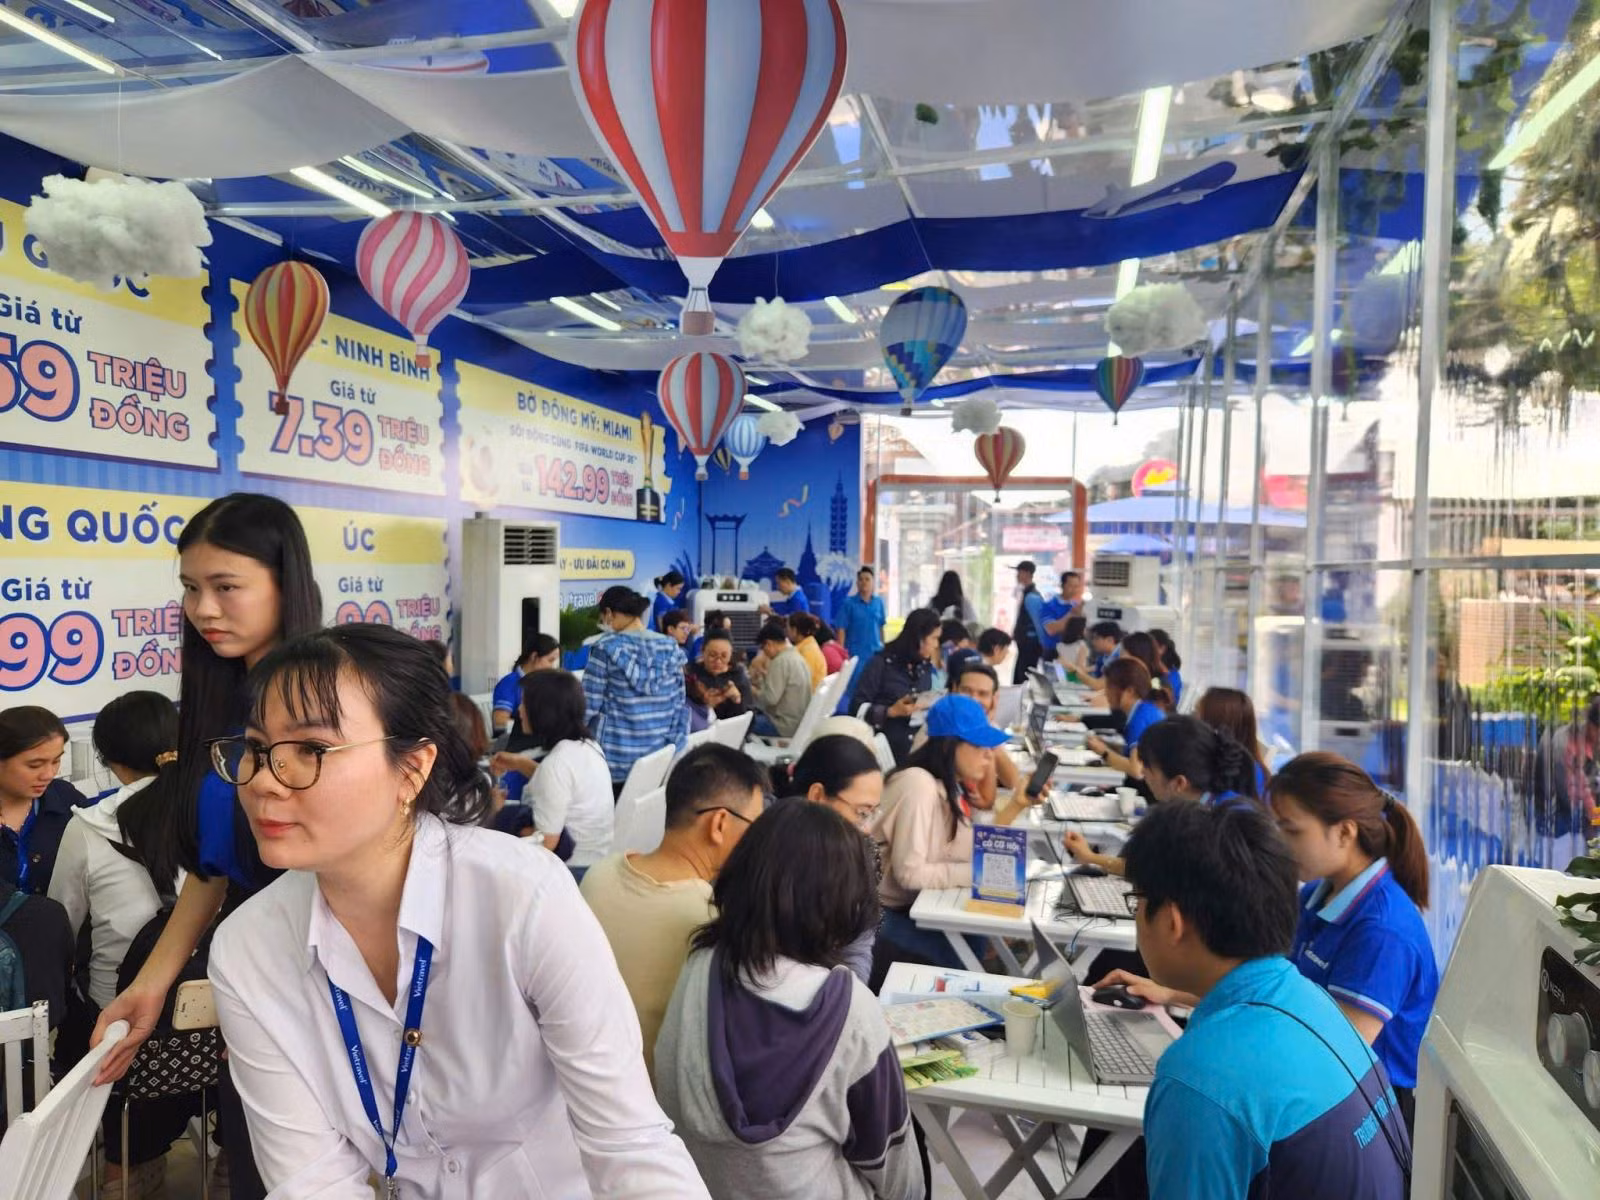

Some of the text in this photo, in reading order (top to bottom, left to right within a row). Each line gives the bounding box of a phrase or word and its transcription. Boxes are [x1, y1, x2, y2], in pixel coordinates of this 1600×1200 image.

[0, 293, 83, 334] Giá từ
[335, 335, 383, 368] NINH
[87, 350, 186, 401] TRIỆU
[330, 380, 377, 405] Giá từ
[90, 393, 189, 441] ĐỒNG
[268, 391, 374, 466] 7.39
[377, 414, 430, 448] TRIỆU
[517, 390, 537, 413] BỜ
[541, 398, 577, 425] ĐÔNG
[603, 419, 632, 441] MIAMI
[379, 444, 430, 476] ĐỒNG
[575, 441, 589, 453] FIFA
[591, 445, 613, 459] WORLD
[615, 450, 626, 462] CUP
[534, 454, 610, 504] 142.99
[67, 501, 185, 545] QUỐC
[343, 520, 376, 552] ÚC
[1, 577, 93, 601] Giá từ
[338, 576, 384, 593] Giá từ
[111, 600, 184, 641] TRIỆ
[396, 594, 441, 621] TRIỆU
[0, 610, 105, 692] 99
[112, 638, 183, 680] ĐỒN
[413, 959, 427, 998] Vietravel
